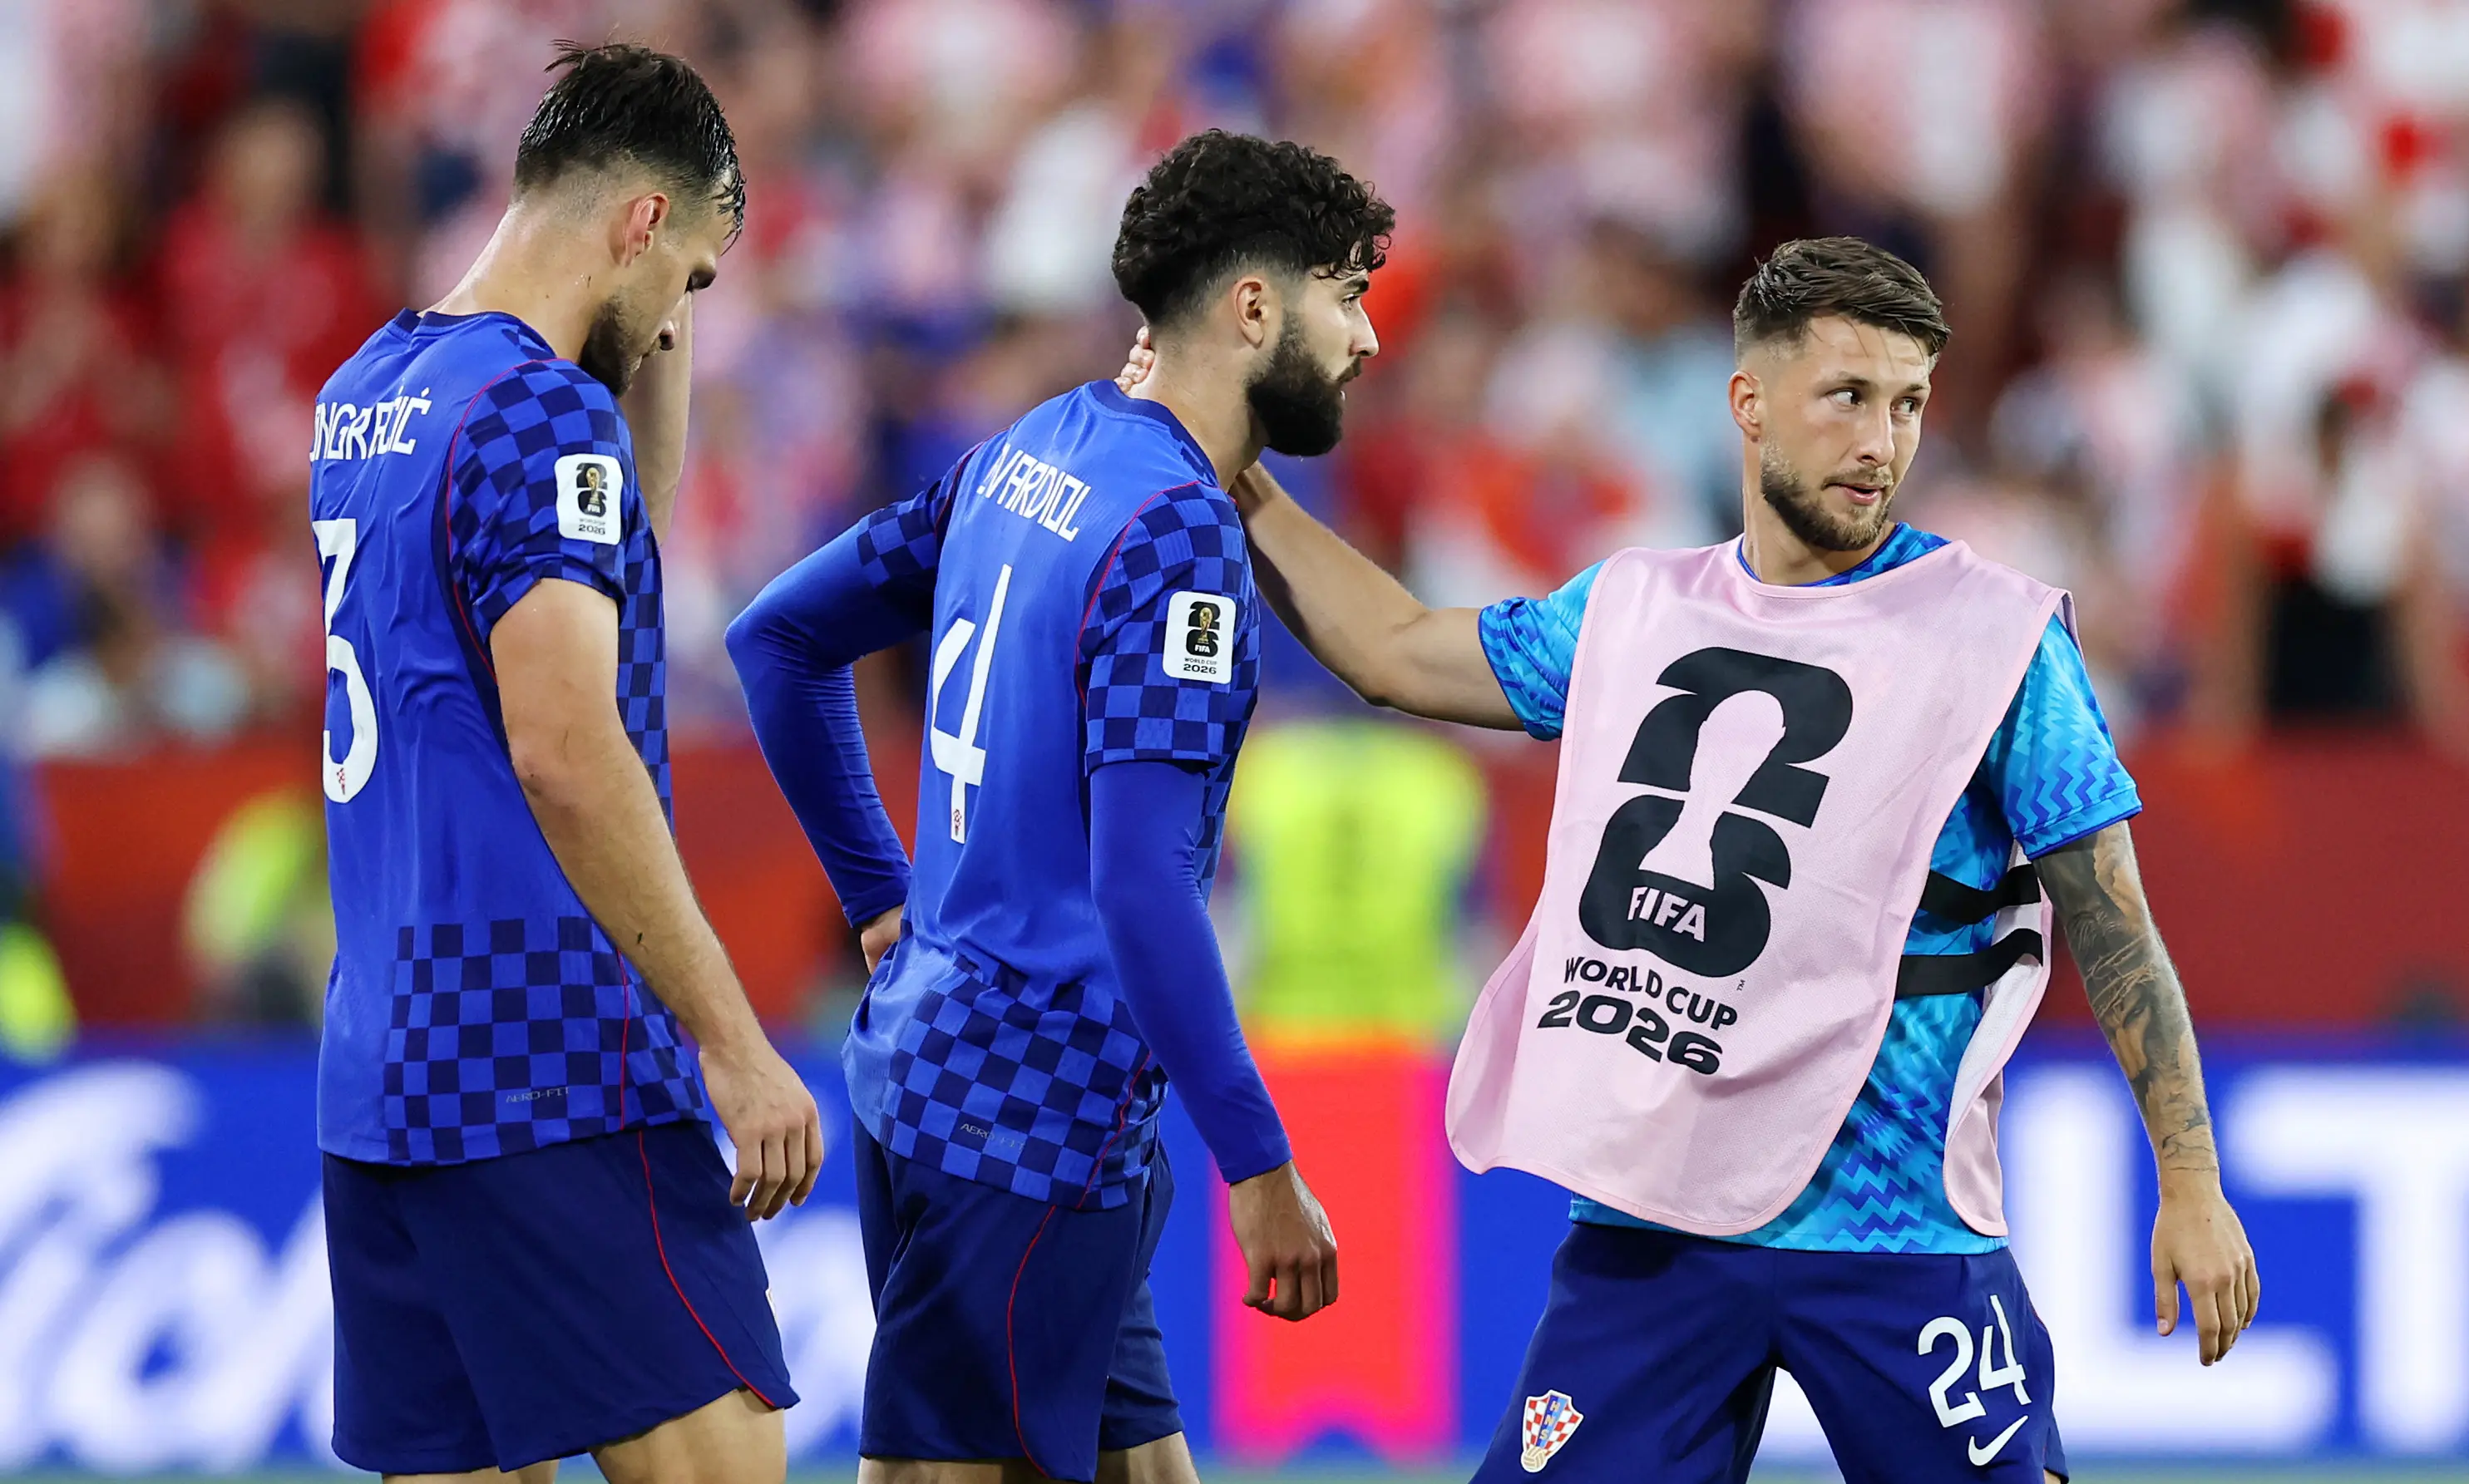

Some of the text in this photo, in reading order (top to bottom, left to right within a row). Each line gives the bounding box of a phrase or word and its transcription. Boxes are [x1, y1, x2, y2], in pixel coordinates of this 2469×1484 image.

[976, 442, 1092, 542] VARDIOL
[312, 518, 379, 804] 3
[1183, 664, 1217, 674] 2026
[1195, 644, 1210, 653] FIFA
[930, 563, 1013, 845] 4
[1627, 885, 1707, 943] FIFA
[1536, 989, 1723, 1076] 2026
[1563, 956, 1738, 1031] WORLD CUP
[960, 1123, 1025, 1151] AEROFIT
[2000, 1064, 2469, 1453] LT
[1918, 1294, 2032, 1428] 24
